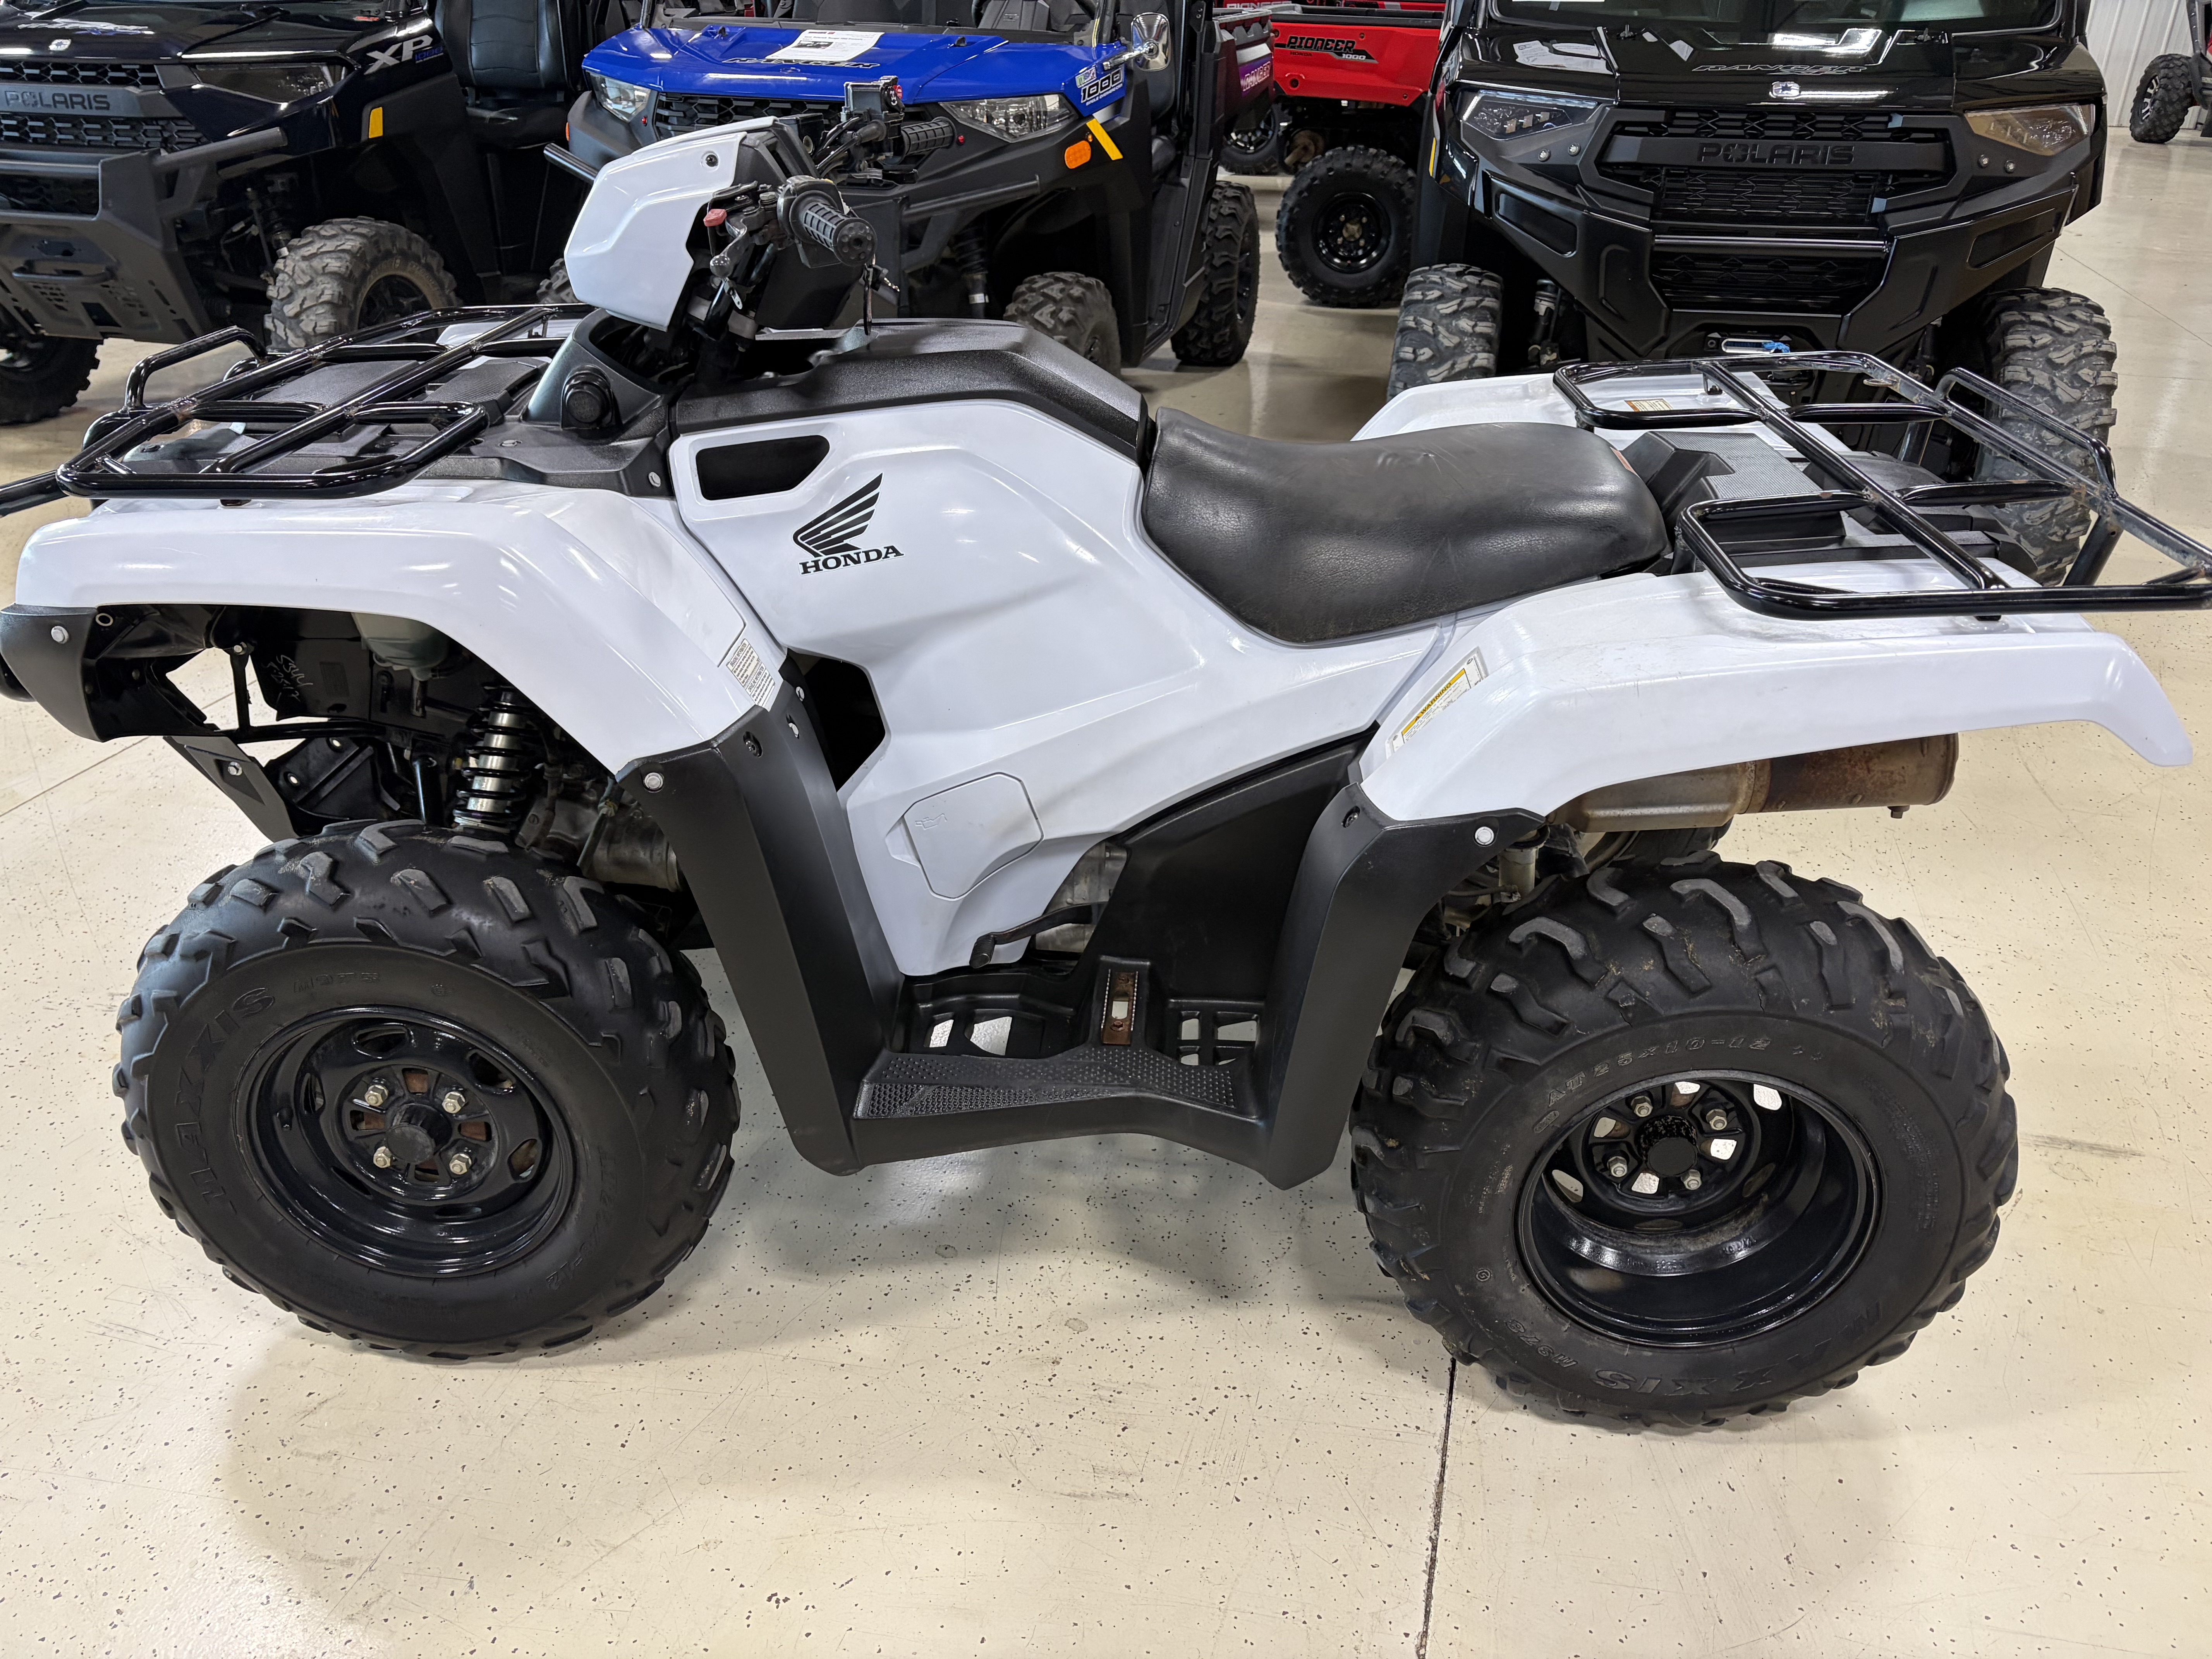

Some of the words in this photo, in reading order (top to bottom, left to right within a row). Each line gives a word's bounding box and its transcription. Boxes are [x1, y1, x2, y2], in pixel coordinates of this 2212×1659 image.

[364, 35, 433, 75] XP
[1285, 36, 1355, 53] PIONEER
[5, 90, 110, 111] POLARIS
[1080, 67, 1122, 104] 1000
[1697, 142, 1856, 166] POLARIS
[799, 545, 904, 575] HONDA
[1420, 682, 1452, 714] WARNING
